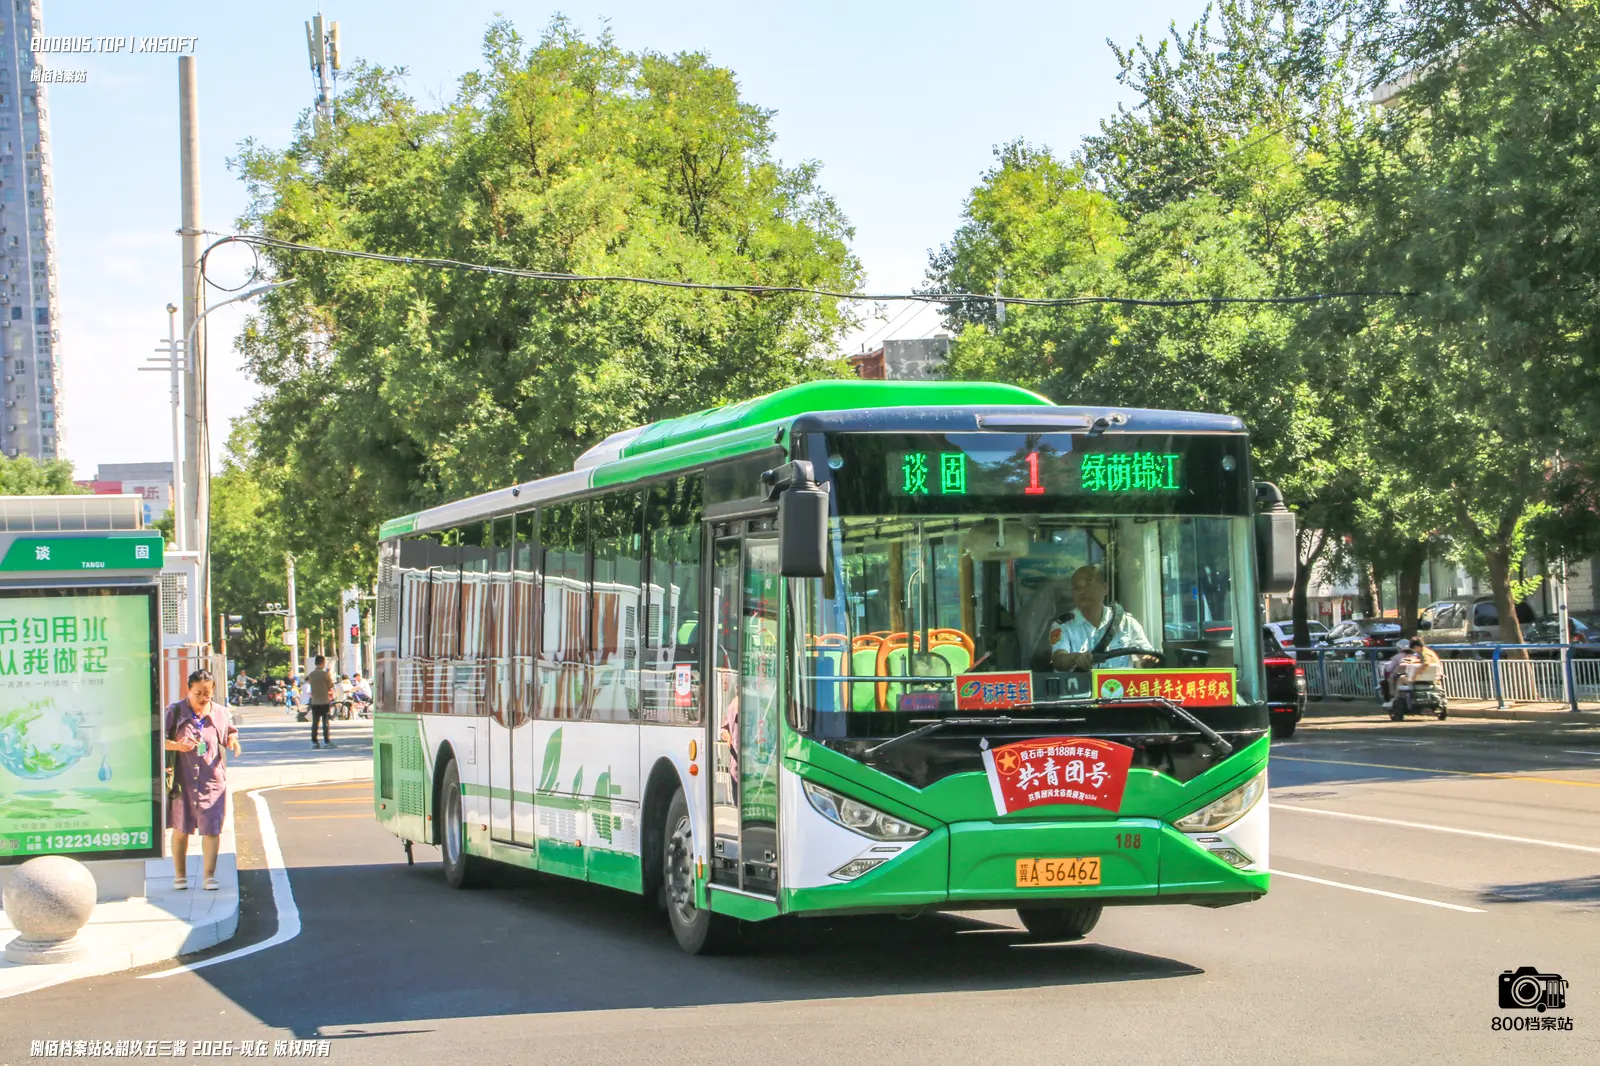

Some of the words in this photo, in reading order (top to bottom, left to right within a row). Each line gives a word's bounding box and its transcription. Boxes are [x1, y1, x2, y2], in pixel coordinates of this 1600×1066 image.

[1025, 452, 1045, 494] 1
[1080, 452, 1180, 491] 绿荫锦江
[0, 615, 108, 644] 节约用水
[0, 646, 108, 675] 从我做起
[982, 681, 1029, 704] 标杆车长
[1125, 679, 1231, 700] 全国青年文明号线路
[1016, 757, 1109, 790] 共青团号
[46, 832, 149, 849] 13223499979
[1115, 833, 1141, 848] 188
